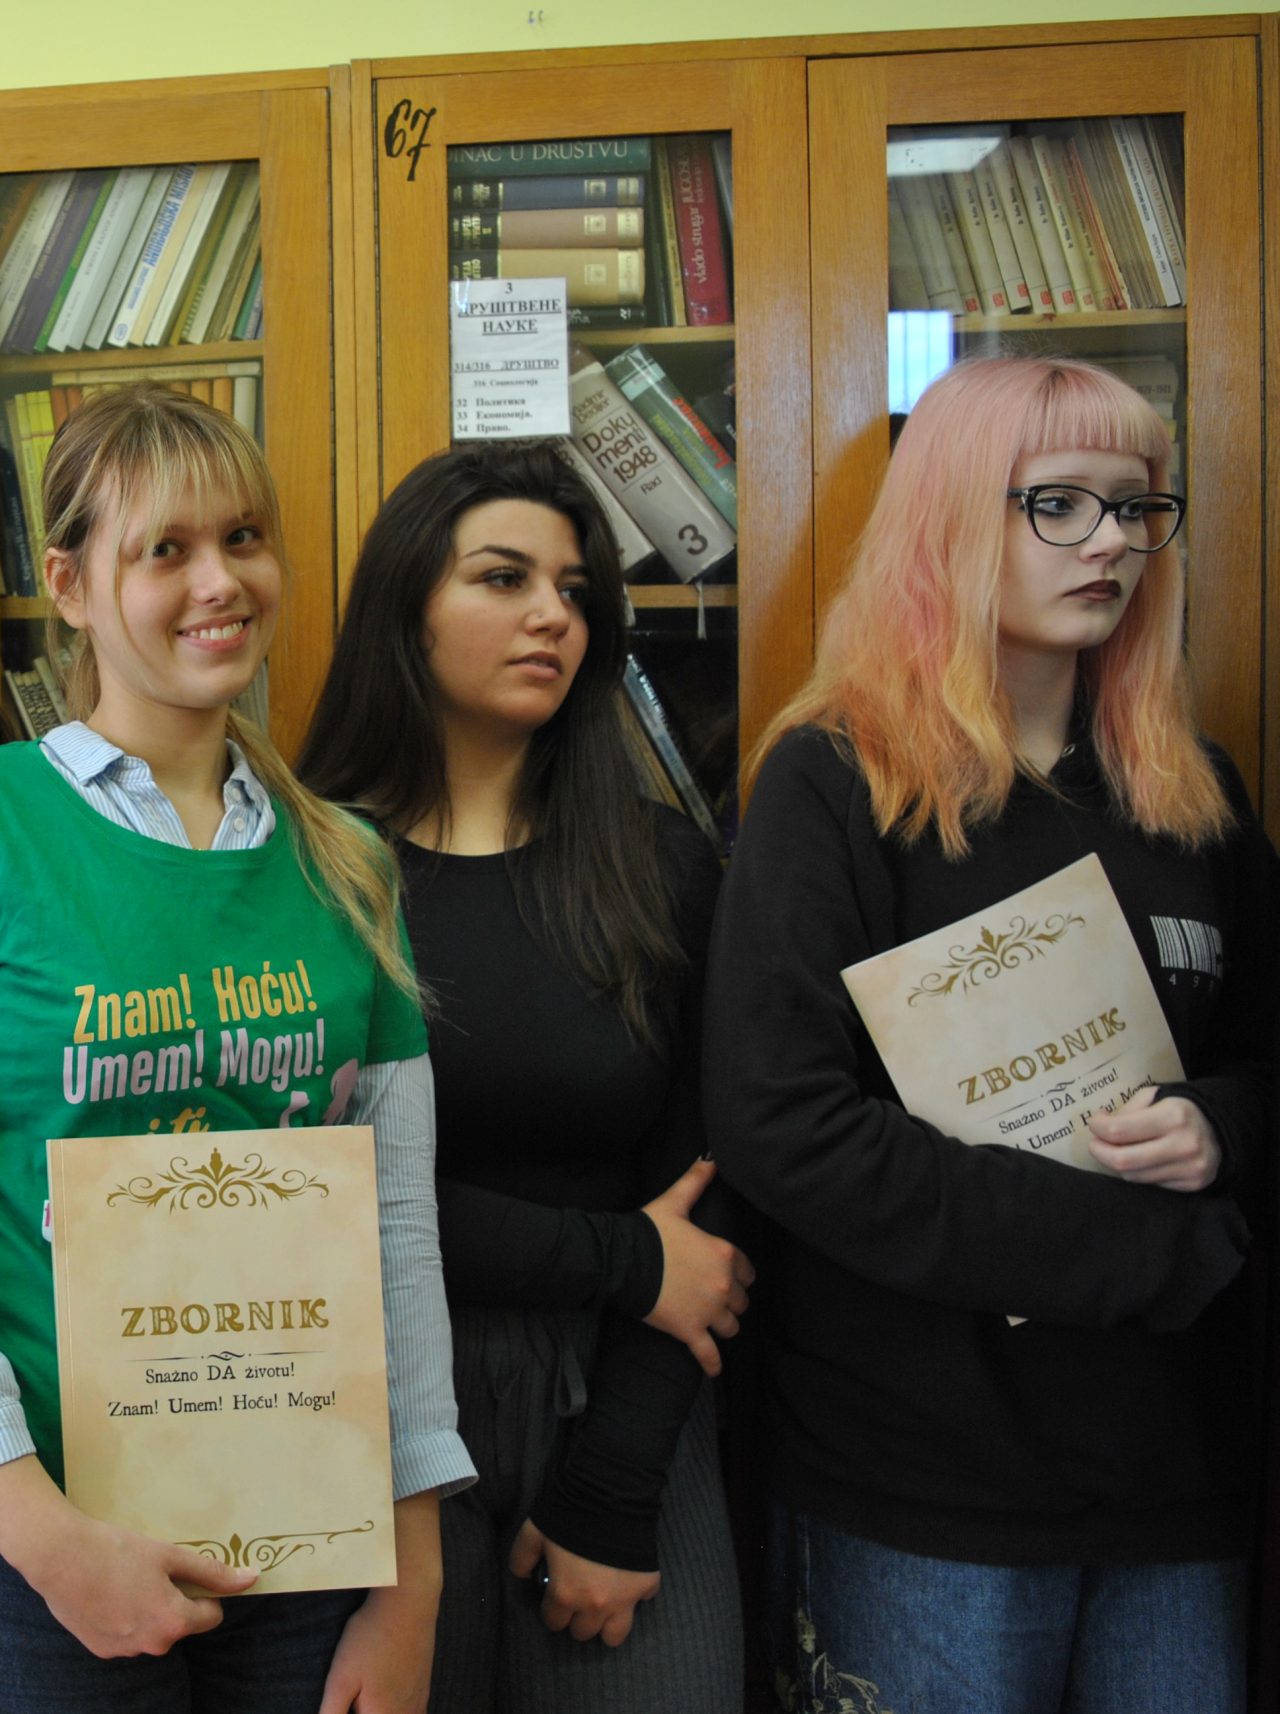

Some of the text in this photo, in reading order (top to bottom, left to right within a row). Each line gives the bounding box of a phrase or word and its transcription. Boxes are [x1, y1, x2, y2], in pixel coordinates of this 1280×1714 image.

[384, 98, 437, 182] 67
[510, 145, 524, 161] U
[532, 140, 628, 160] DRUŠTVU
[690, 248, 707, 284] vlado
[505, 282, 513, 294] 3
[482, 319, 538, 335] НАУКЕ
[501, 359, 559, 371] ДРУШТВО
[582, 413, 635, 455] Doku
[612, 445, 658, 484] 1948
[640, 476, 663, 496] Rad
[678, 524, 709, 556] 3
[73, 960, 318, 1044] Znam! Hoću!
[62, 1018, 325, 1105] Umem! Mogu!
[958, 1007, 1127, 1105] ZBORNIK
[998, 1067, 1119, 1135] Snažno DA životu!
[1027, 1120, 1075, 1150] Umem!
[121, 1298, 330, 1338] ZBORNIK
[145, 1361, 295, 1384] Snažno DA životu!
[108, 1390, 336, 1417] Znam! Umem! Hoću! Mogu!
